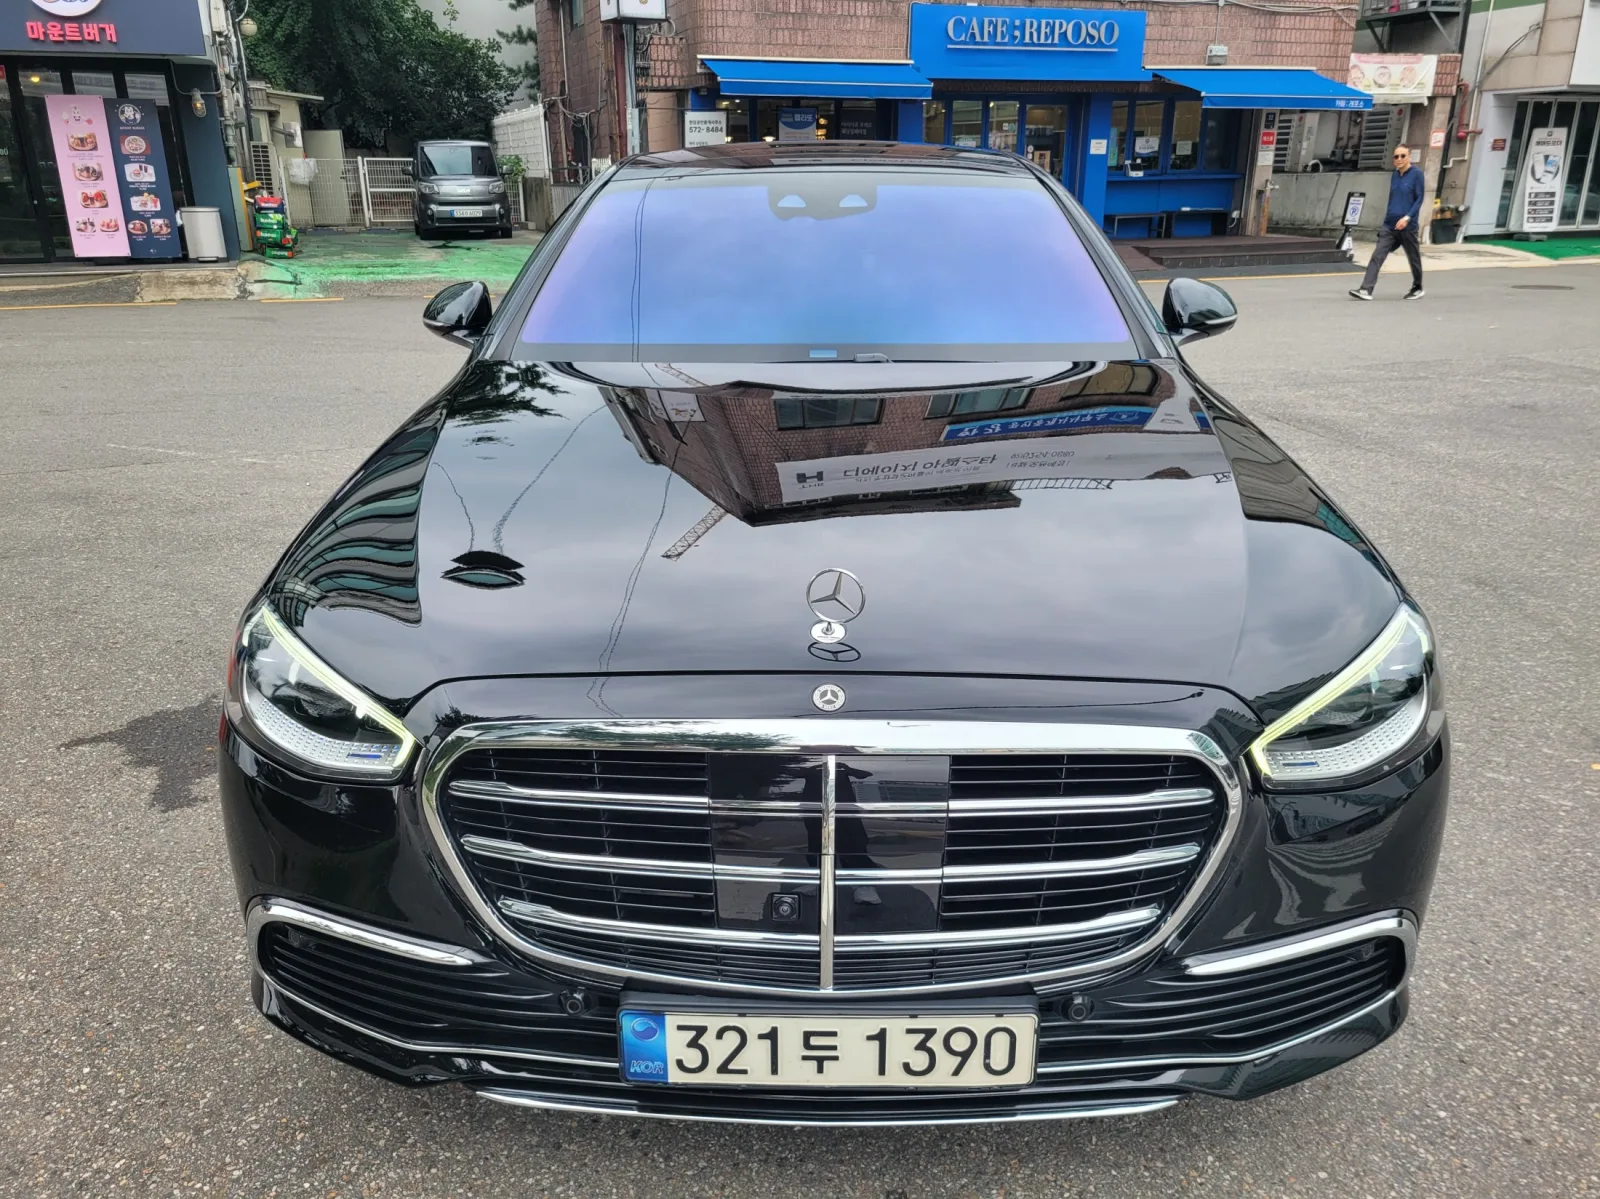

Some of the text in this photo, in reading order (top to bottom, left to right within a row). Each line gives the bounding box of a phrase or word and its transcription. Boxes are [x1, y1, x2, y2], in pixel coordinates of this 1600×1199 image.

[26, 21, 117, 43] 마운트버거
[675, 1024, 1016, 1077] 321두 1390
[630, 1060, 664, 1074] KOR
